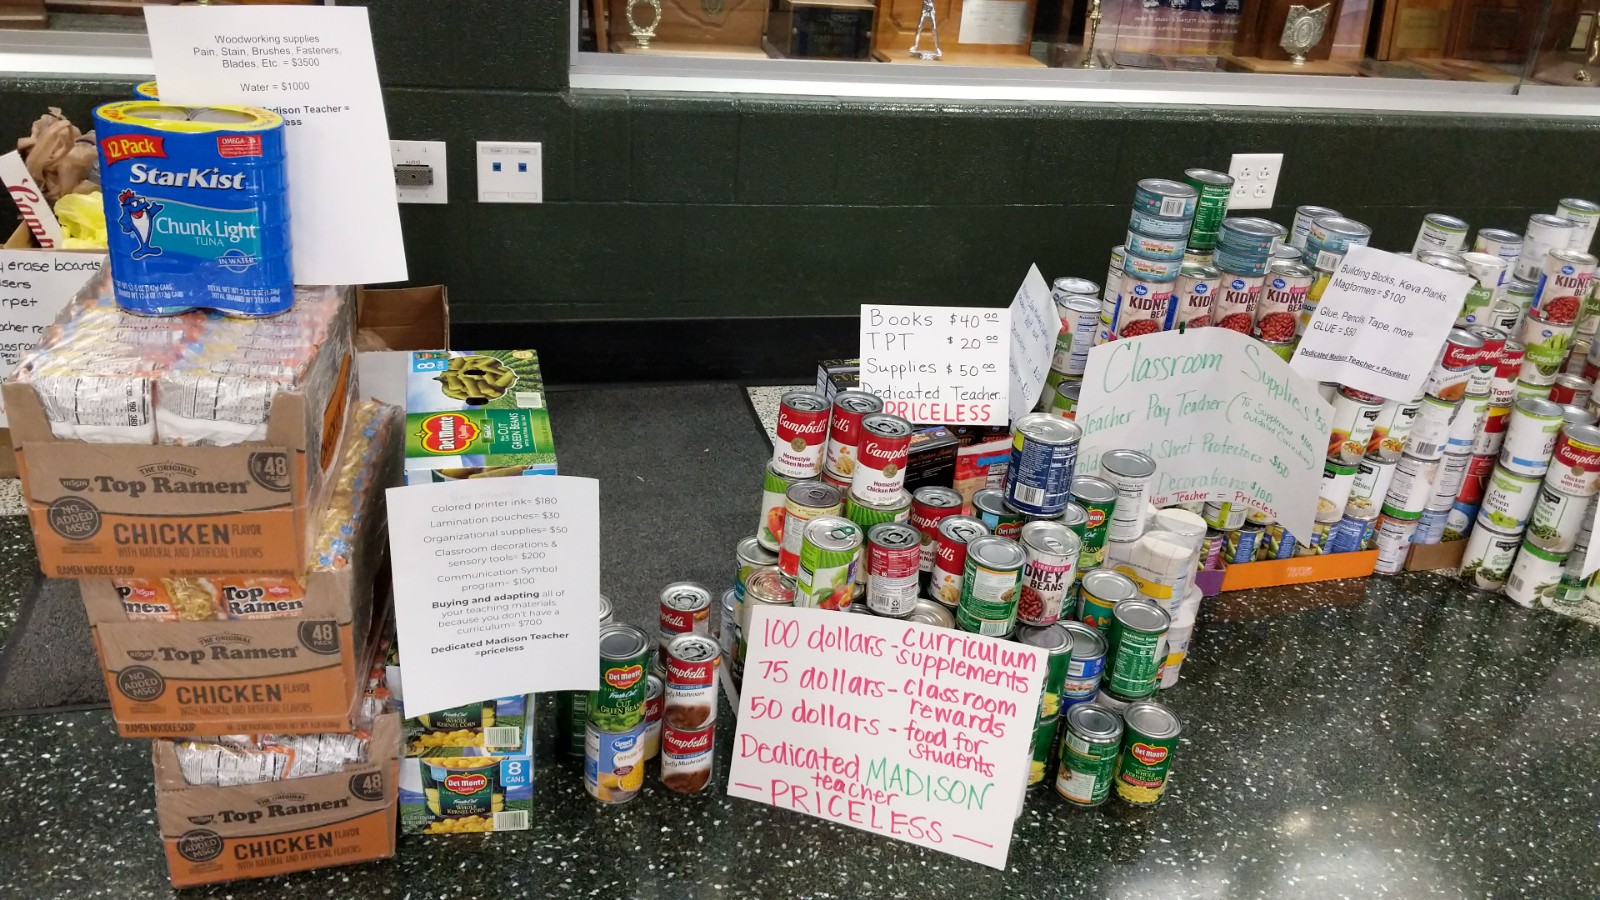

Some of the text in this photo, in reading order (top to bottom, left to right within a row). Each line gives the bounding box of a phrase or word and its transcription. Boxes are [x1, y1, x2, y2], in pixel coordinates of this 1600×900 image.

[215, 35, 319, 44] Woodworking supplies
[194, 47, 341, 56] Pain, Stain, Brushes, Fasteners,
[223, 60, 259, 68] Blades,
[292, 59, 319, 67] $3500
[240, 82, 310, 91] Water $1000
[305, 105, 341, 113] Teacher
[122, 139, 156, 154] Pack
[130, 164, 247, 190] StarKist
[156, 217, 256, 242] Chunk Light
[195, 237, 224, 246] TUNA
[8, 258, 100, 272] erase boards
[1333, 278, 1406, 304] Magformers $100
[1341, 264, 1448, 302] Building Blocks, Keva Planks,
[1555, 275, 1590, 289] KIDNE
[1267, 289, 1306, 305] KIDNE
[870, 309, 933, 327] Books
[1320, 307, 1414, 338] Glue, Tape, more
[1313, 321, 1357, 336] GLUE $50
[867, 332, 914, 351] TPT
[867, 358, 936, 379] Supplies
[1300, 348, 1410, 381] Dedicated Madison Teacher Priceless!
[1103, 342, 1224, 393] Classroom
[1241, 344, 1309, 421] Supplies
[861, 382, 939, 400] Dedicated
[885, 401, 991, 422] PRICELESS
[1079, 389, 1228, 437] Teacher Pay Teacher
[439, 416, 453, 436] Monte
[510, 413, 522, 449] GREEN BEANS
[779, 411, 827, 434] Campbell's
[783, 452, 811, 462] Homestyle
[1158, 433, 1263, 464] Sheet Protectors
[778, 458, 815, 468] Chicken Noodle
[94, 476, 246, 498] Top Ramen
[1157, 468, 1273, 504] Decorations $100
[1563, 474, 1586, 484] Chicken
[1571, 482, 1585, 490] Rice
[867, 485, 888, 493] Chicken
[1493, 488, 1506, 500] Cut
[432, 497, 558, 513] Colored printer ink= $180
[1172, 491, 1278, 518] Teacher Priceless
[1486, 500, 1508, 513] Beans
[1488, 492, 1510, 508] Green
[56, 511, 94, 525] ADDED
[431, 511, 560, 528] Lamination pouches= $30
[113, 523, 262, 545] CHICKEN FLAVOR
[424, 526, 568, 543] Organizational supplies= $50
[435, 540, 549, 557] Classroom decorations
[448, 552, 545, 568] sensory tools= $200
[56, 565, 135, 576] RAMEN SOUP
[437, 566, 558, 583] Communication Symbol
[462, 577, 535, 592] program= $100
[1030, 580, 1063, 591] BEANS
[432, 598, 468, 609] Buying
[472, 596, 491, 604] and
[494, 591, 540, 603] adapting
[442, 599, 556, 618] your teaching materials
[439, 609, 552, 628] because you don't have
[457, 618, 542, 635] curriculum= $700
[312, 624, 332, 640] 48
[431, 632, 569, 654] Dedicated Madison Teacher
[475, 645, 524, 657] =priceless
[763, 618, 1037, 672] 100 dollars curriculum
[159, 646, 296, 664] Top Ramen
[608, 670, 641, 681] Del Monte
[666, 659, 707, 679] Campbell's
[896, 649, 1029, 693] supplements
[176, 683, 281, 704] CHICKEN
[759, 660, 1017, 717] 75 dollars classroom
[600, 705, 623, 715] GREEN
[909, 699, 1006, 738] rewards
[751, 696, 988, 755] 50 dollars food for
[664, 731, 709, 748] Campbell's
[508, 762, 521, 775] 8
[678, 757, 707, 766] Mushroom
[909, 743, 995, 777] students
[740, 733, 994, 810] Dedicated MADISON
[461, 779, 484, 787] Monte
[811, 772, 899, 806] teacher
[218, 798, 347, 824] Top Ramen
[771, 779, 943, 844] PRICELESS
[234, 831, 334, 860] CHICKEN
